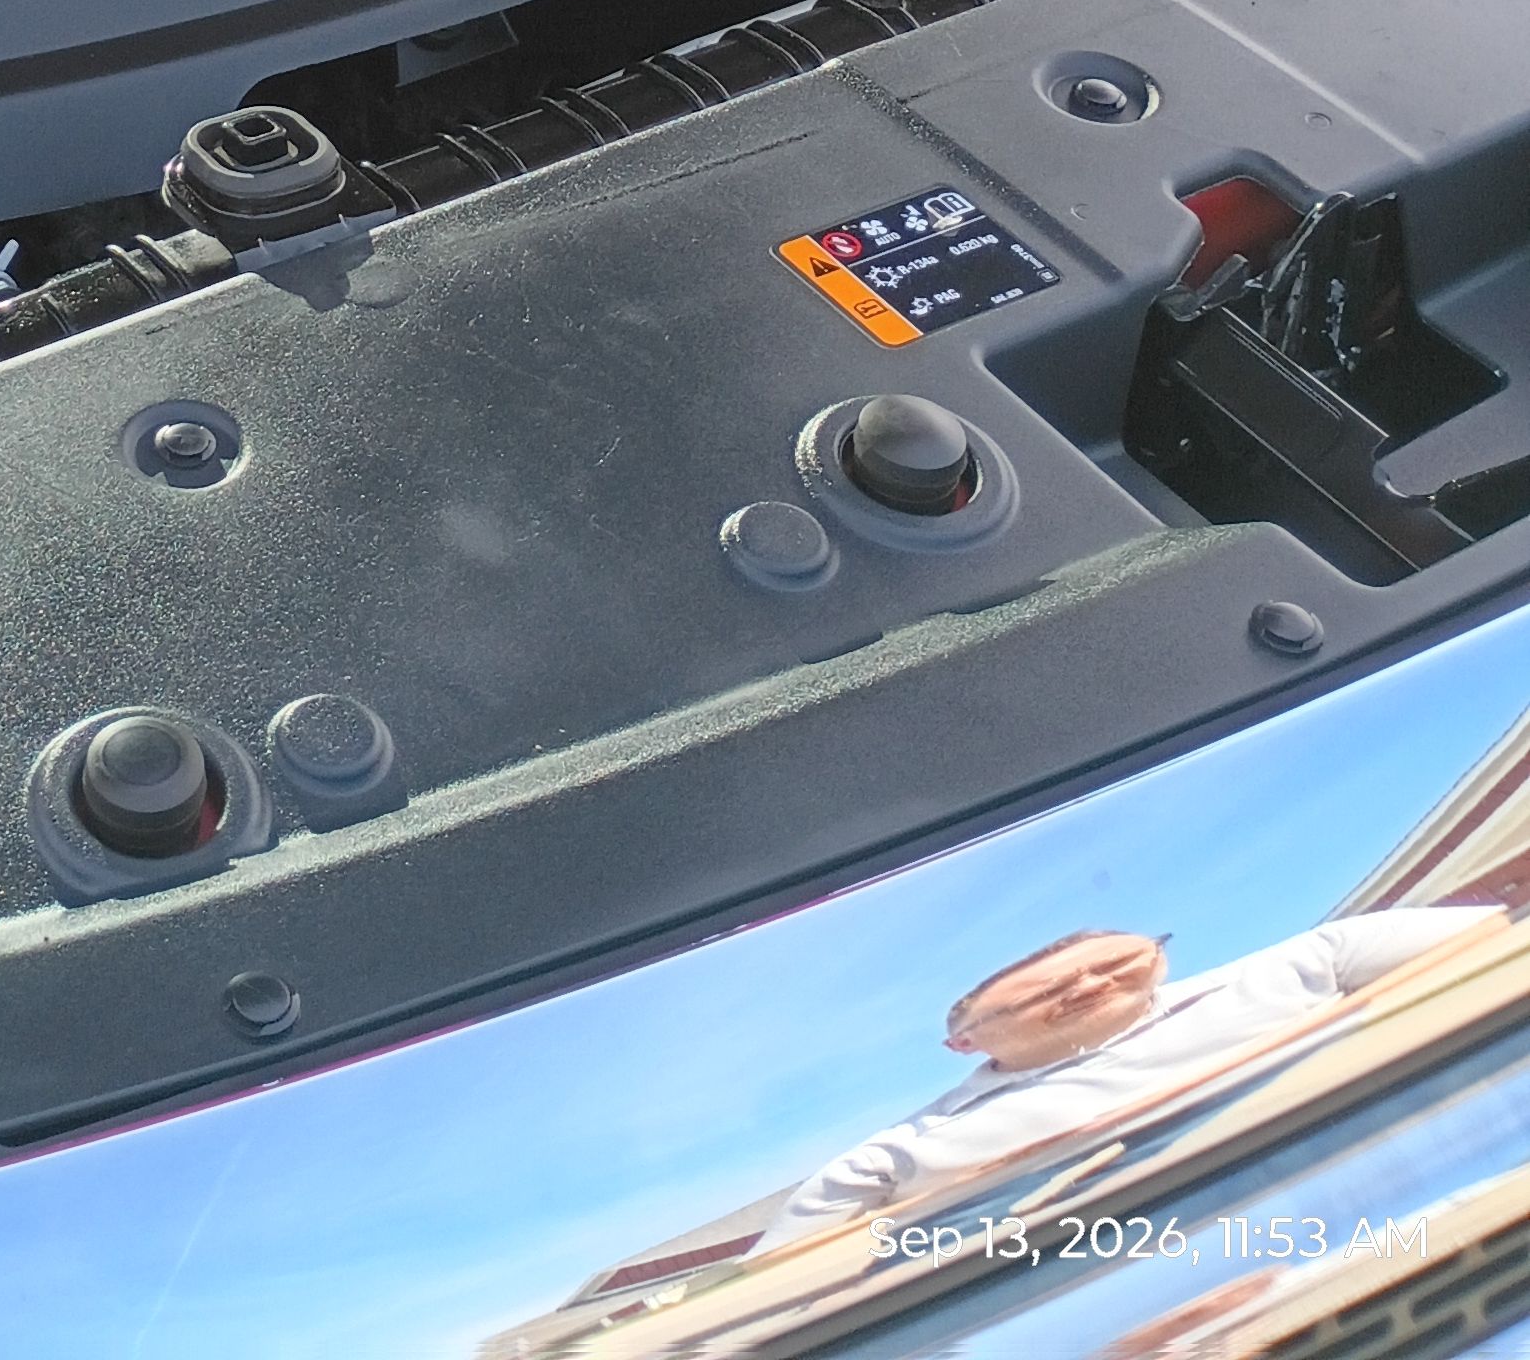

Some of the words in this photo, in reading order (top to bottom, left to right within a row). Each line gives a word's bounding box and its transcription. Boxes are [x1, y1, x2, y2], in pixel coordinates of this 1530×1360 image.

[874, 231, 902, 246] AUTO
[977, 233, 999, 244] kg
[933, 288, 961, 304] PAG
